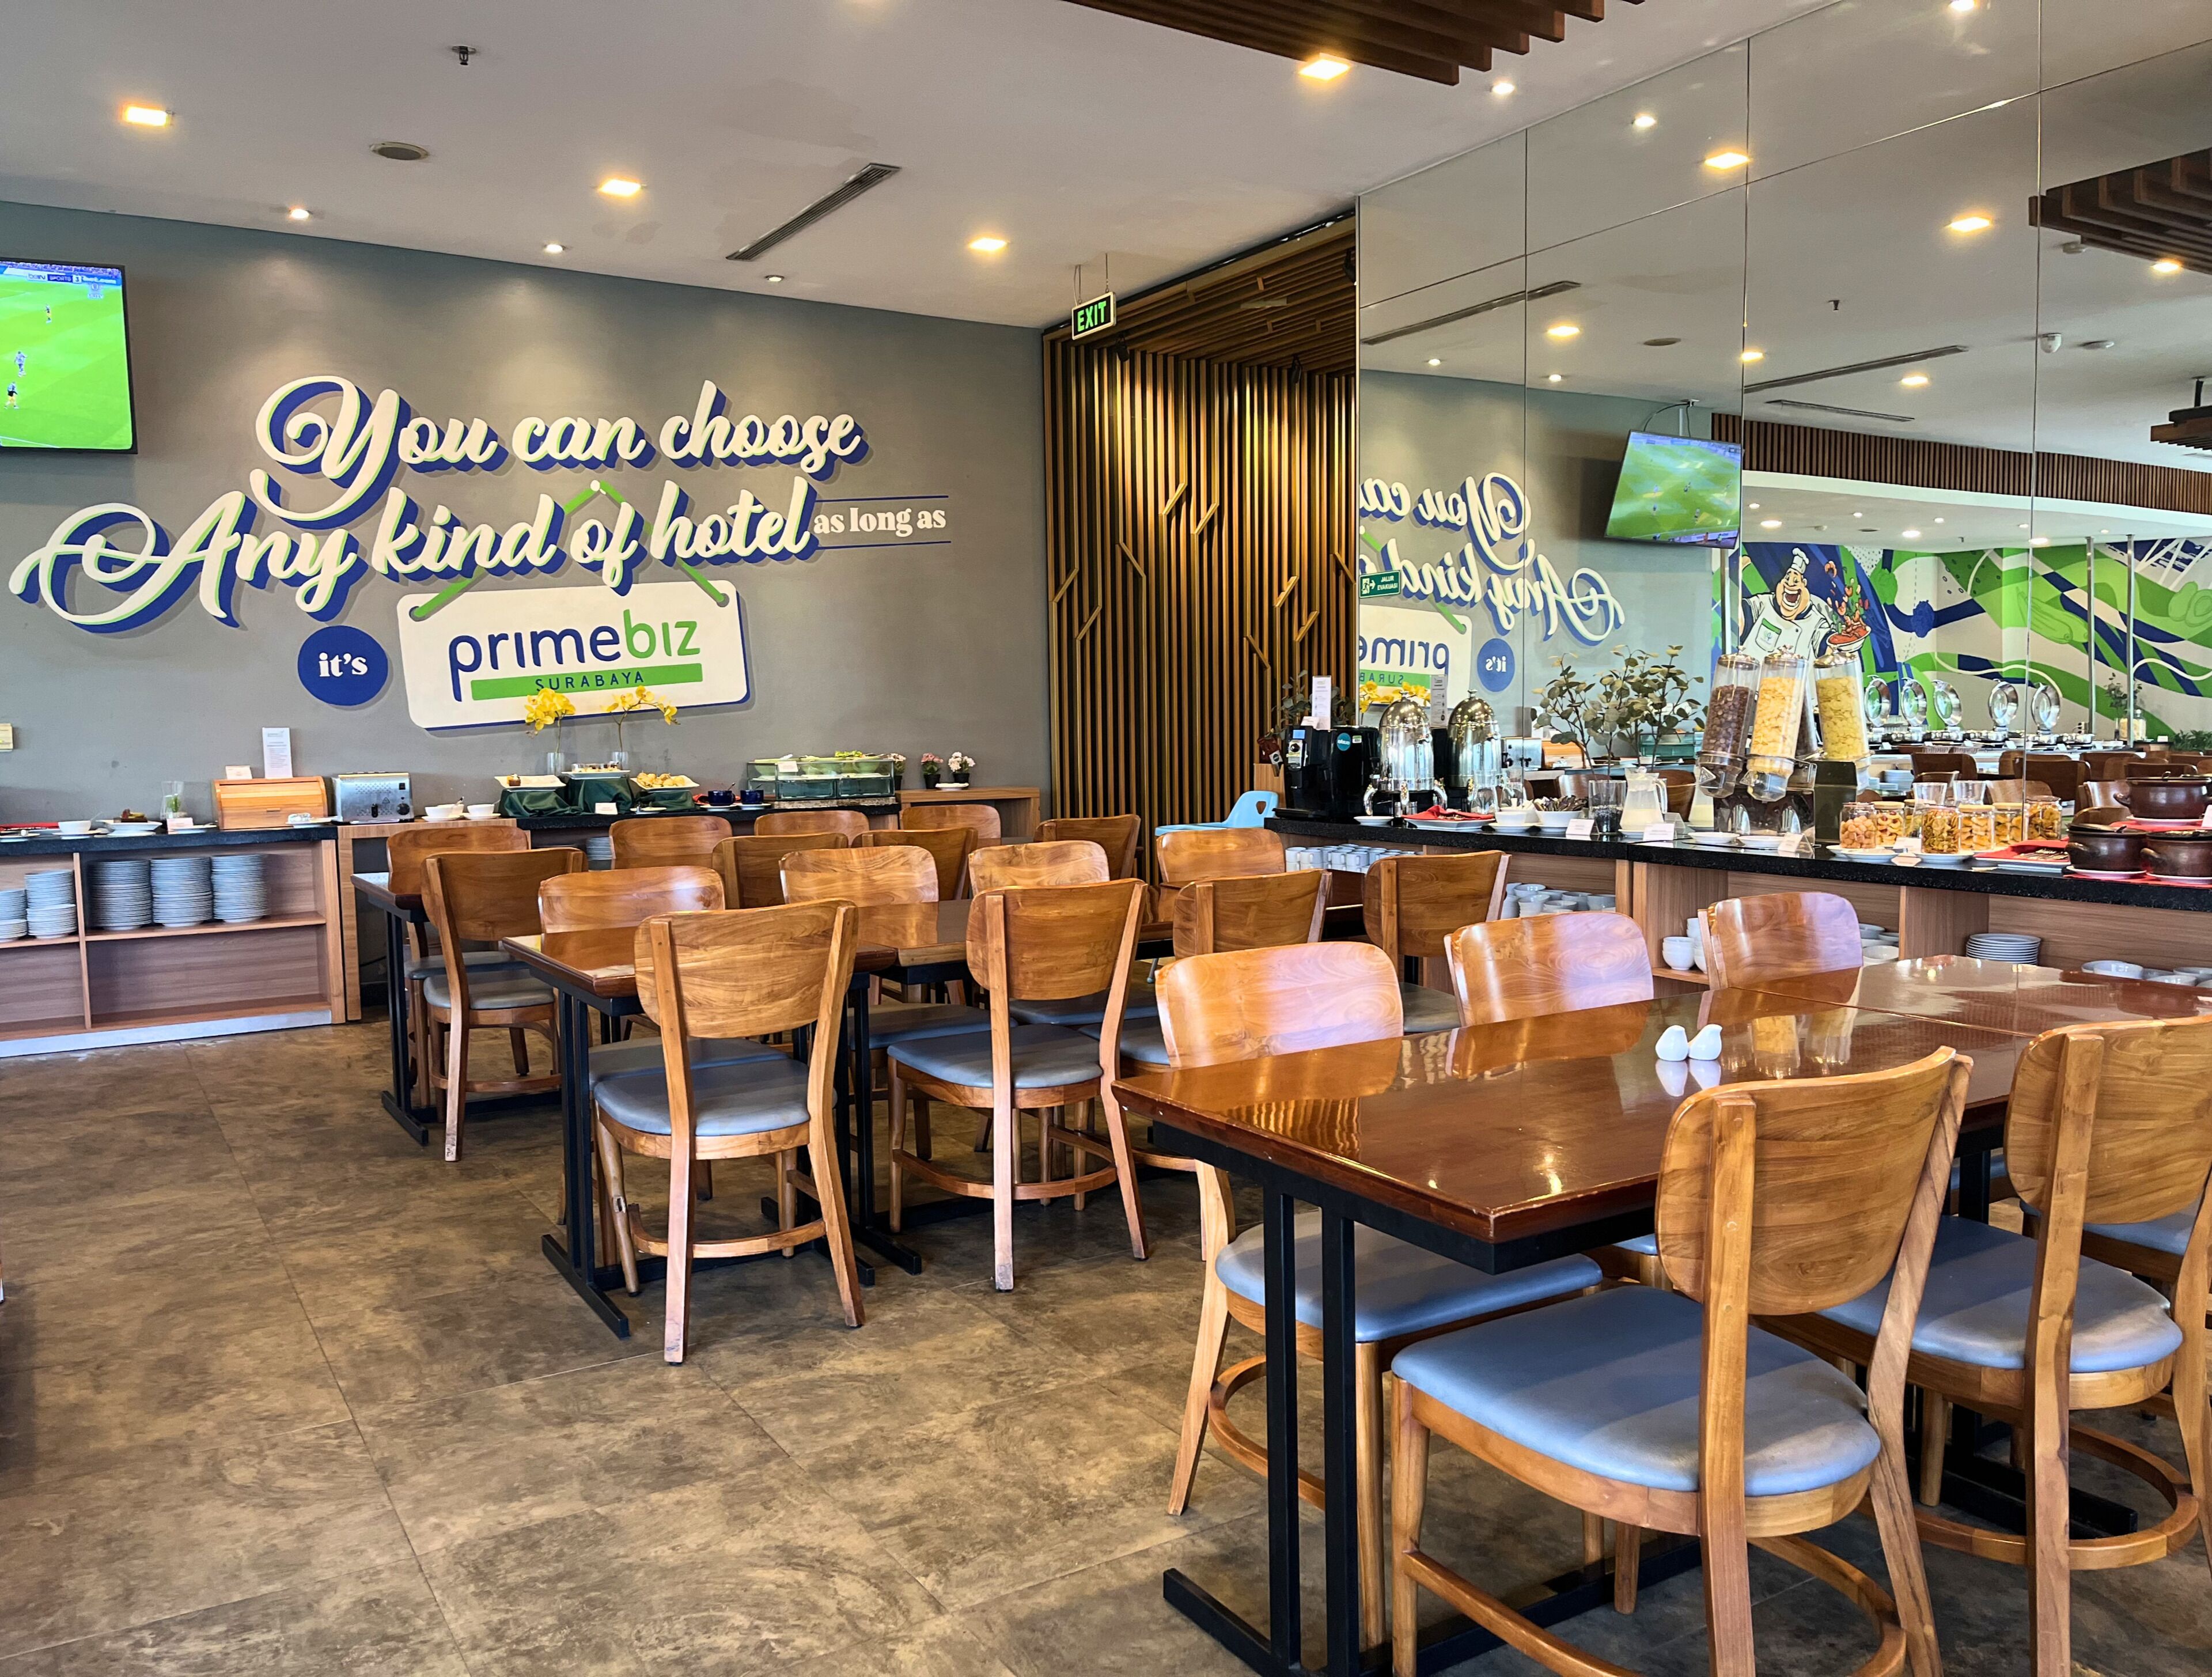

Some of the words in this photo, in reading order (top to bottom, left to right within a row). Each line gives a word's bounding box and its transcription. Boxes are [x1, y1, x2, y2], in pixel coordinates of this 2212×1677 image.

[1077, 300, 1107, 332] EXIT
[249, 376, 502, 525] You
[512, 417, 651, 466] can
[660, 380, 865, 477] choose
[813, 513, 845, 534] as
[850, 508, 913, 537] long
[916, 509, 946, 529] as
[9, 491, 363, 629] Any
[372, 487, 562, 578] kind
[570, 502, 643, 592] of
[650, 476, 814, 563] hotel
[1377, 582, 1398, 590] EVAKUASI
[318, 652, 368, 677] it's
[449, 610, 700, 702] primebiz
[535, 671, 644, 692] SURABAYA
